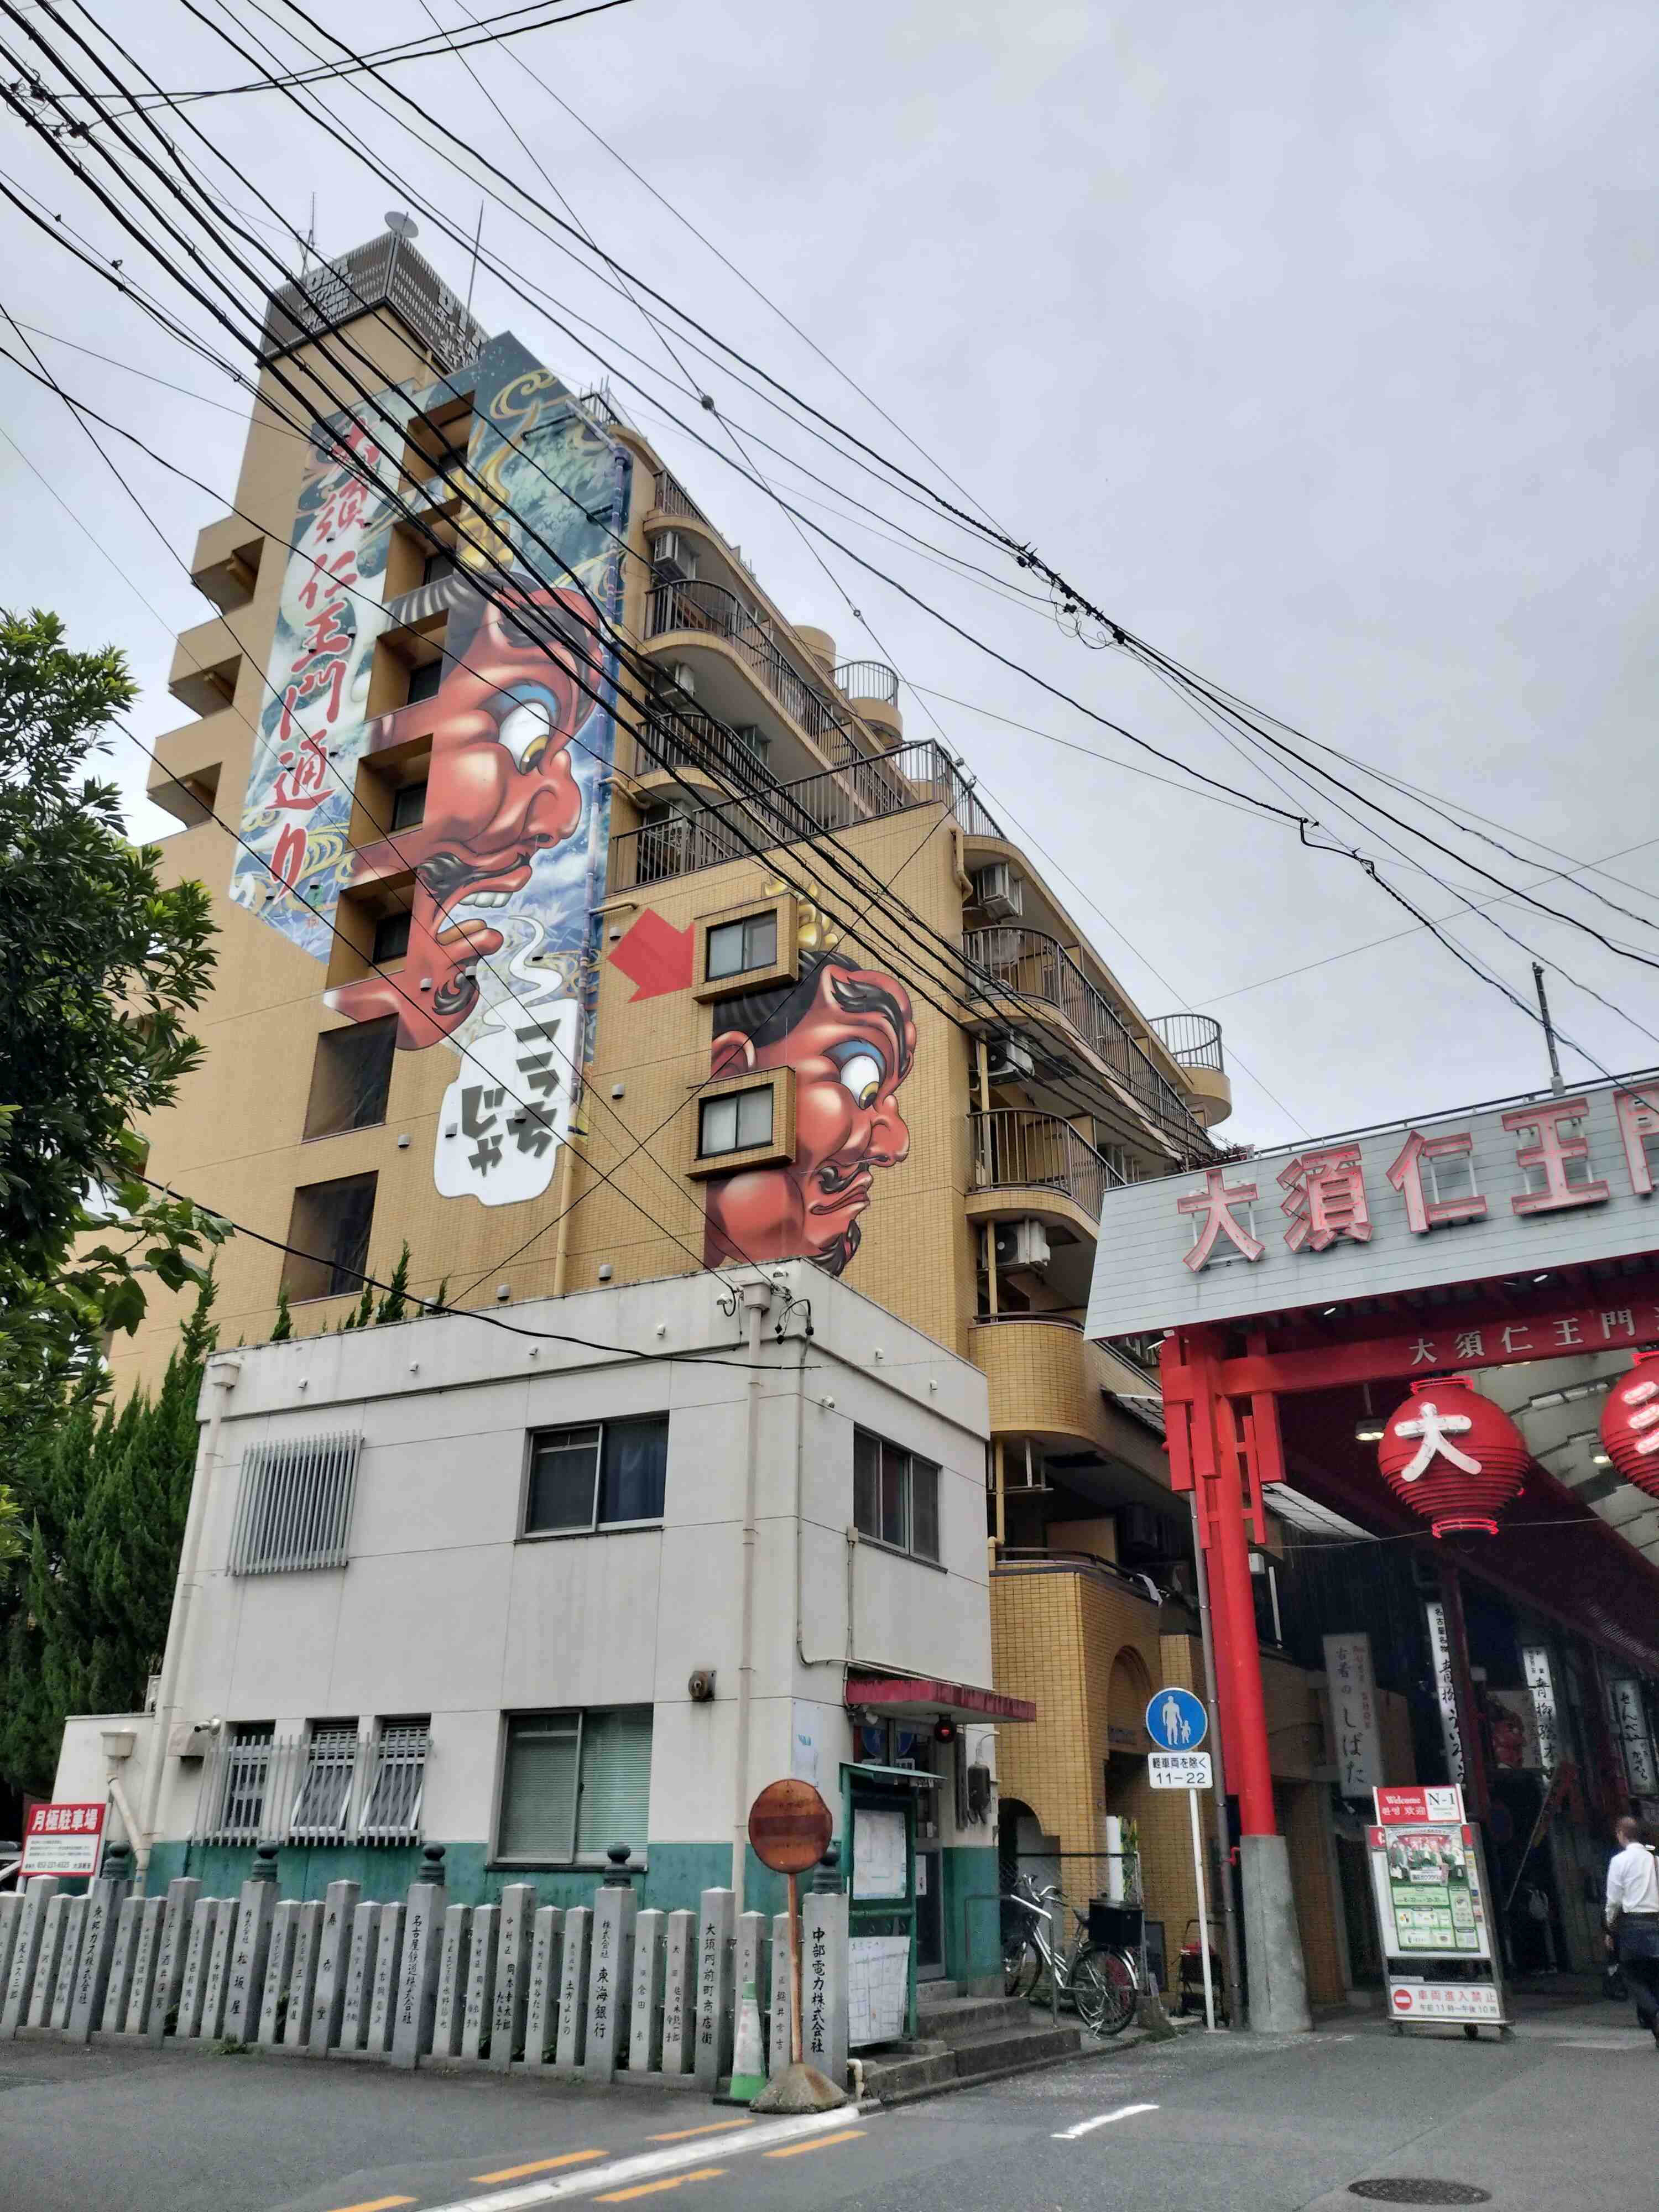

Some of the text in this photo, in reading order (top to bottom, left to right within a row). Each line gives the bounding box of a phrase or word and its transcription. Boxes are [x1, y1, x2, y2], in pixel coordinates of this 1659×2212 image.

[265, 416, 380, 902] 大須仁王門通り
[506, 1019, 561, 1158] こっち
[462, 1085, 505, 1177] じゃ
[1410, 1307, 1659, 1366] 大須仁王門
[1395, 1403, 1482, 1482] 大
[1152, 1757, 1207, 1768] 軽車両を除く
[1156, 1772, 1206, 1784] 11-22
[32, 1808, 98, 1831] 月極駐車場
[1385, 1793, 1455, 1805] Welcome N-1
[230, 1952, 248, 2014] 松坂屋
[594, 1920, 611, 2039] 株式会社 東海銀行
[702, 1923, 716, 2044] 大須門前町商店街
[811, 1927, 825, 2053] 中部電力株式会社
[1418, 1990, 1495, 2002] 車両進入禁止
